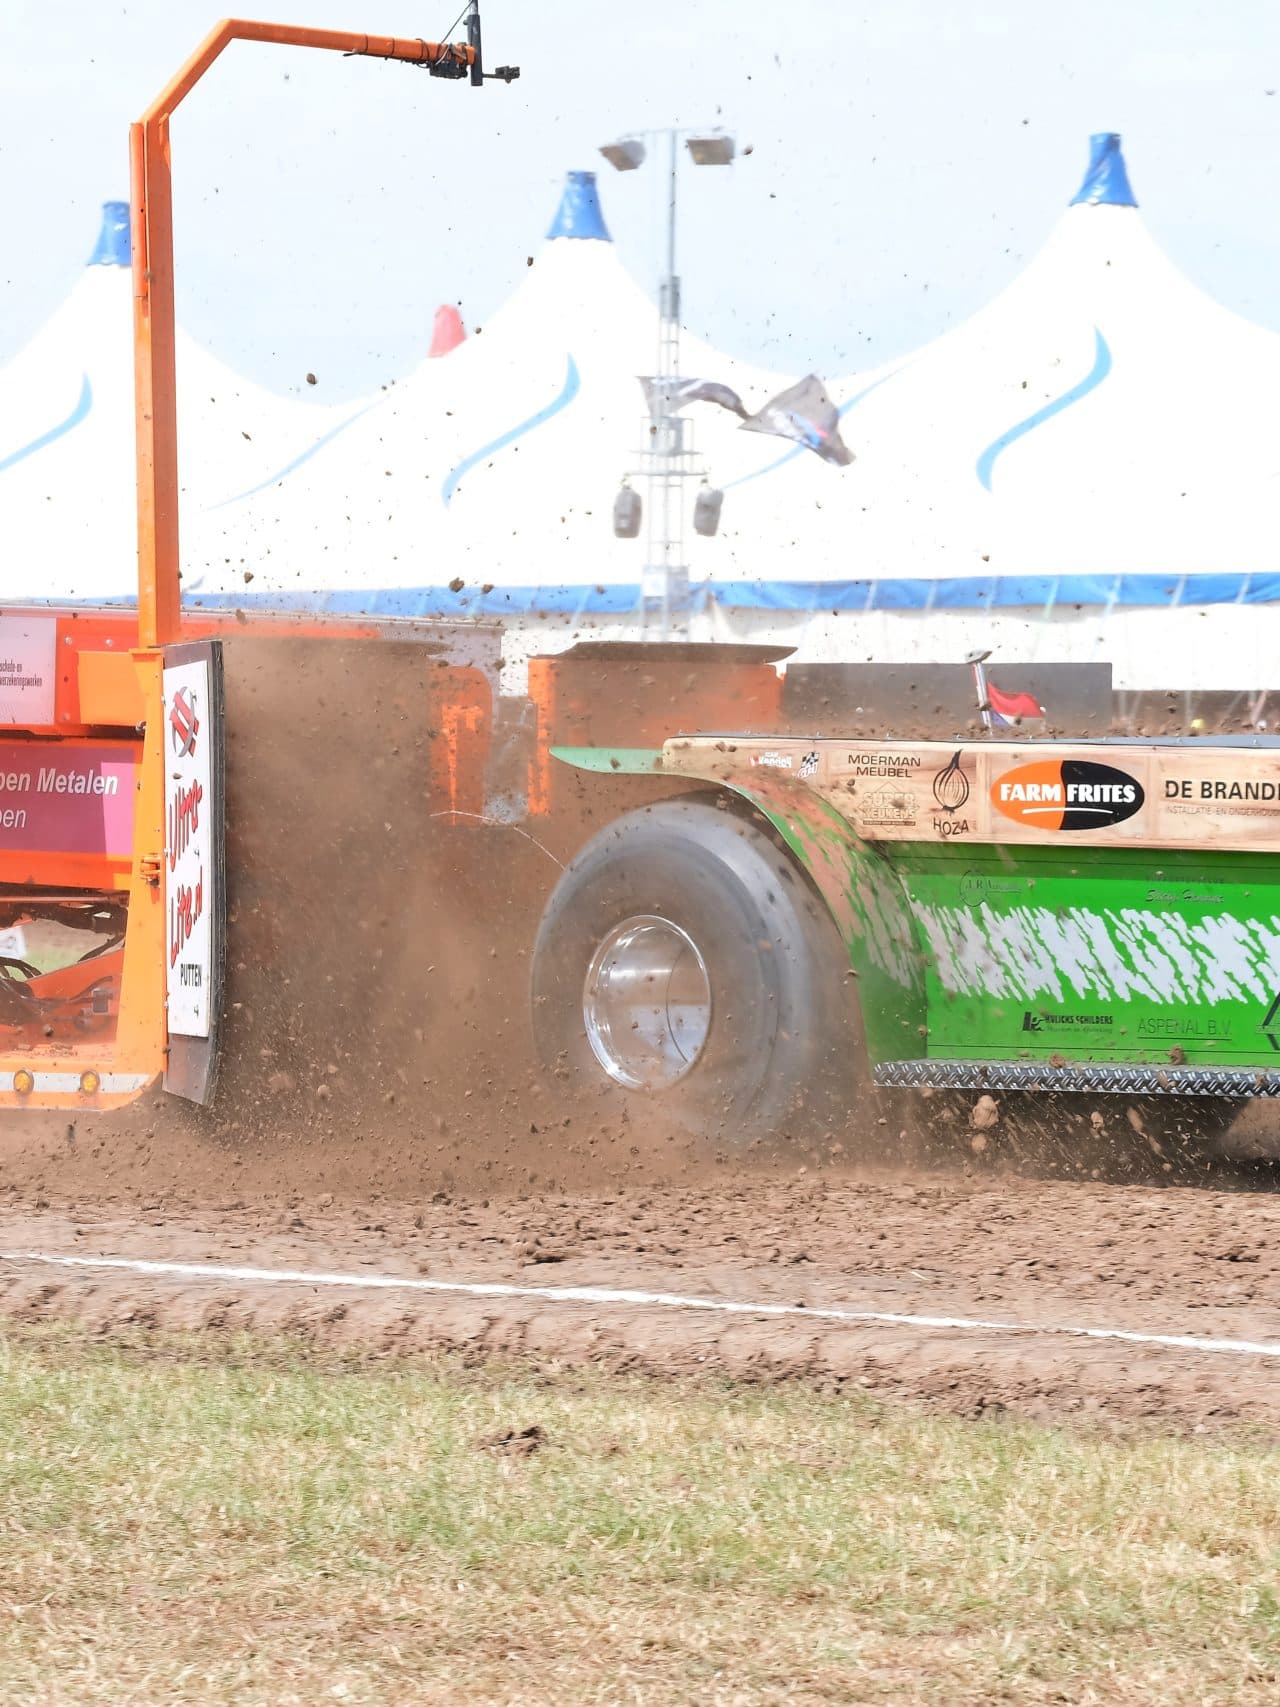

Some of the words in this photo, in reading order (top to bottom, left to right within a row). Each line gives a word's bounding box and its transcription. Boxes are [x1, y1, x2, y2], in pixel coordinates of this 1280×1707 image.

[848, 754, 921, 767] MOERMAN
[37, 767, 119, 795] Metalen
[856, 766, 913, 778] MEUBEL
[1000, 783, 1061, 802] FARM
[1066, 783, 1136, 803] FRITES
[1165, 780, 1192, 798] DE
[933, 818, 969, 835] HOZA
[180, 963, 203, 987] PUTTEN
